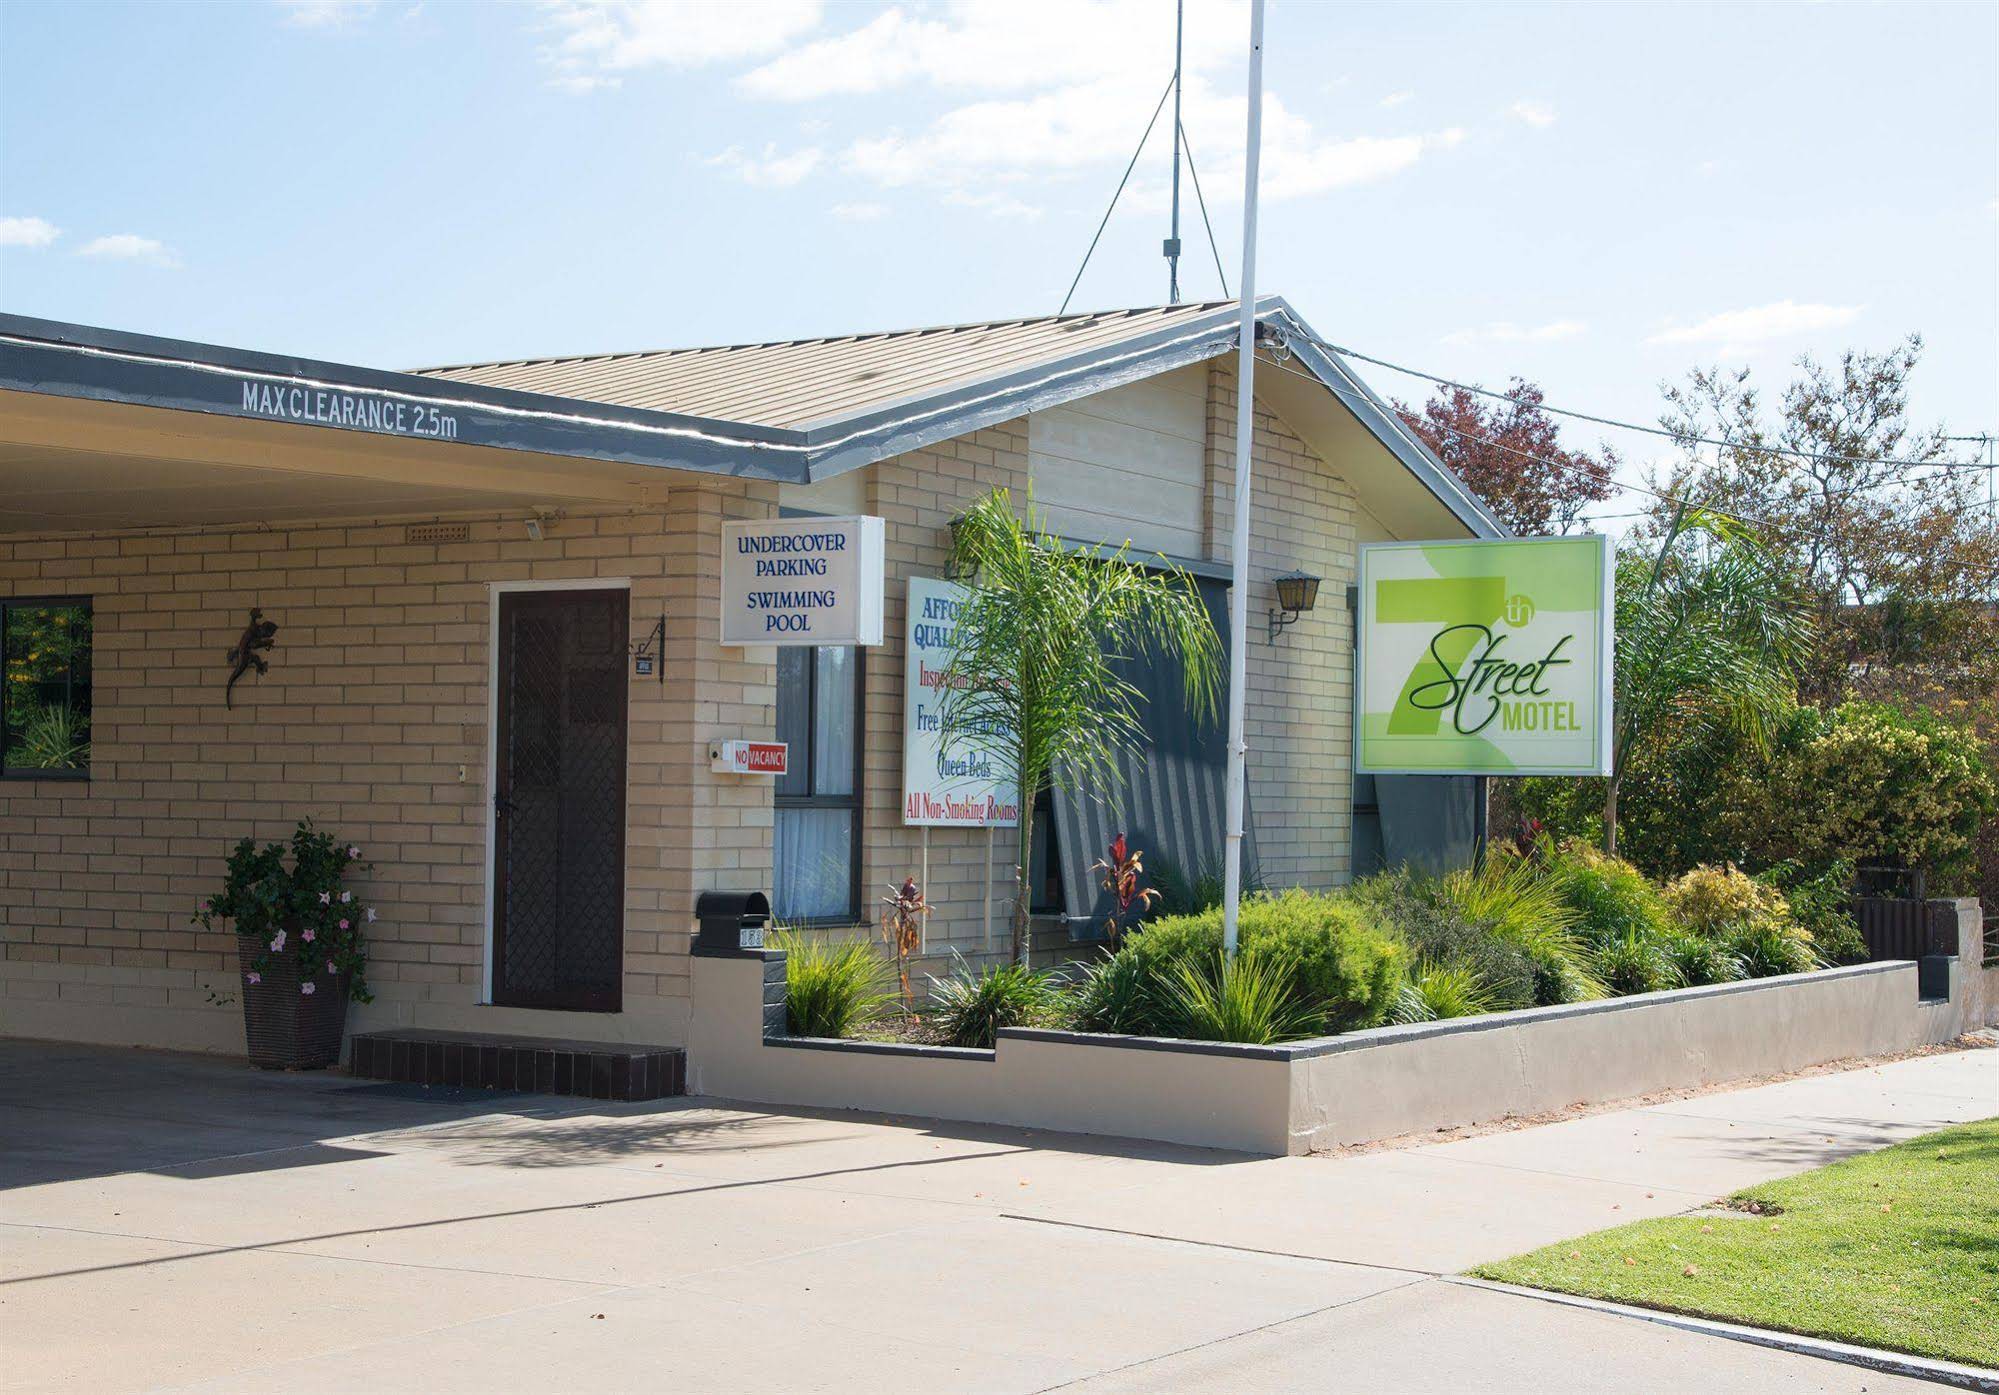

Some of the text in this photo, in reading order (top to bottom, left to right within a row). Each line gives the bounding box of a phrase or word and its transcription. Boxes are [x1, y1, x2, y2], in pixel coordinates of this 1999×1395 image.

[243, 382, 457, 438] MAX CLEARANCE 2.5m
[738, 534, 846, 553] UNDERCOVER
[756, 558, 827, 577] PARKING
[747, 590, 835, 609] SWIMMING
[766, 614, 811, 631] POOL
[1409, 624, 1573, 734] Street
[917, 704, 938, 731] Free
[1502, 702, 1580, 731] MOTEL
[735, 750, 785, 766] NO VACANCY
[937, 750, 991, 780] Queen Beds
[906, 792, 1017, 824] All Non-Smoking Rooms
